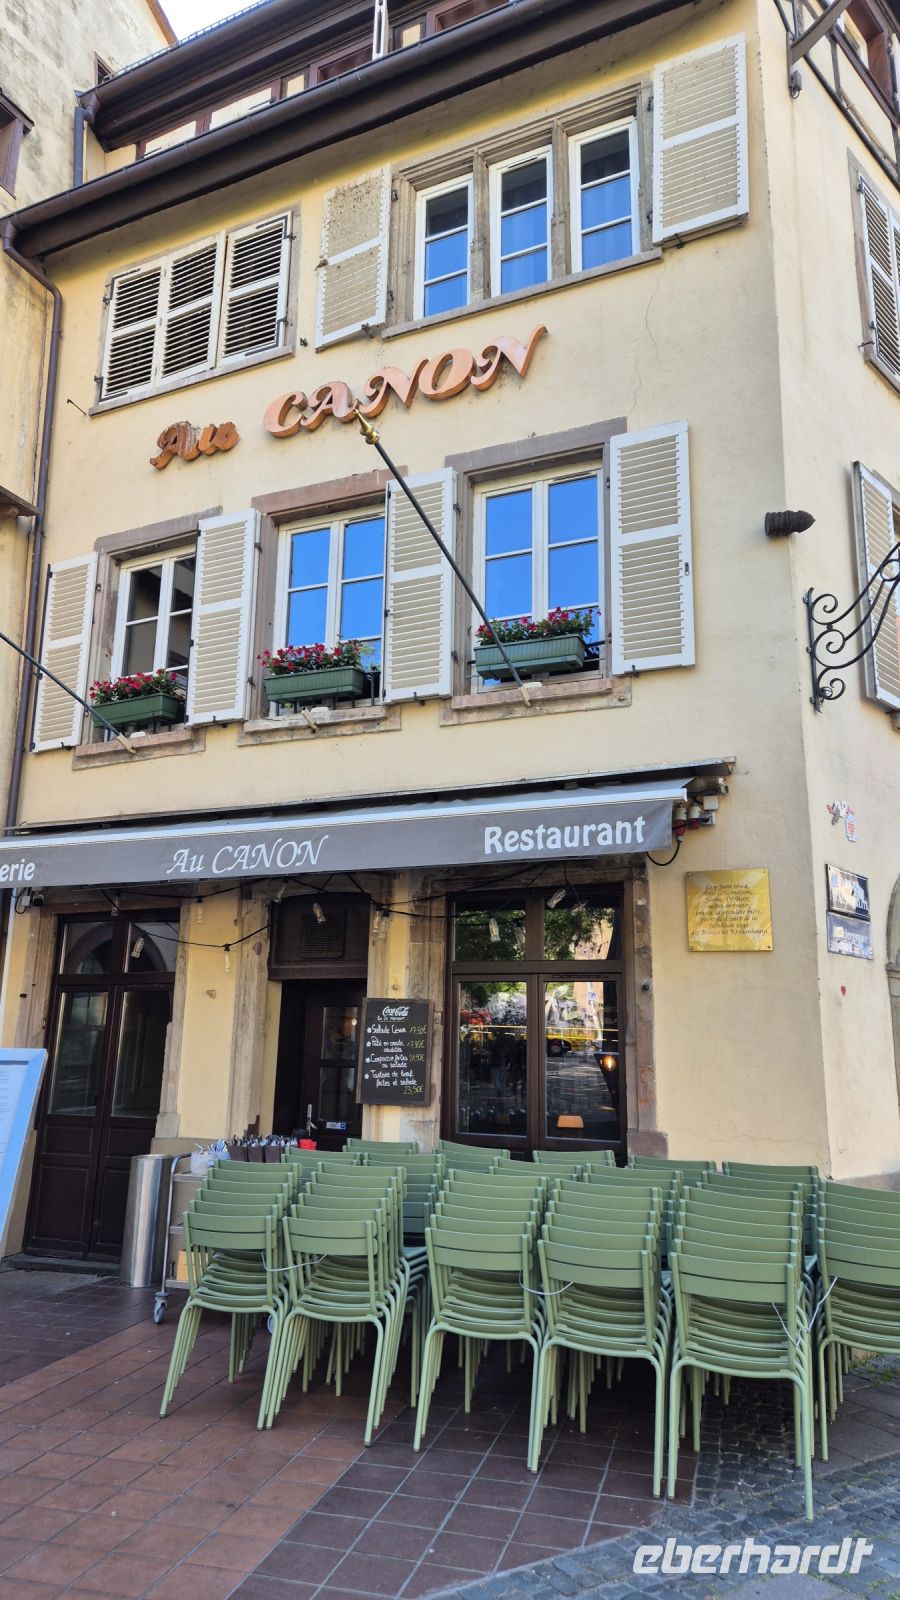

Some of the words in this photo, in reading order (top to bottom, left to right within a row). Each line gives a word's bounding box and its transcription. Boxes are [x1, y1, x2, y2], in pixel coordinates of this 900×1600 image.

[149, 421, 239, 470] Au
[263, 324, 549, 438] CANON
[166, 849, 204, 874] Au
[211, 834, 329, 874] CANON
[484, 816, 646, 854] Restaurant
